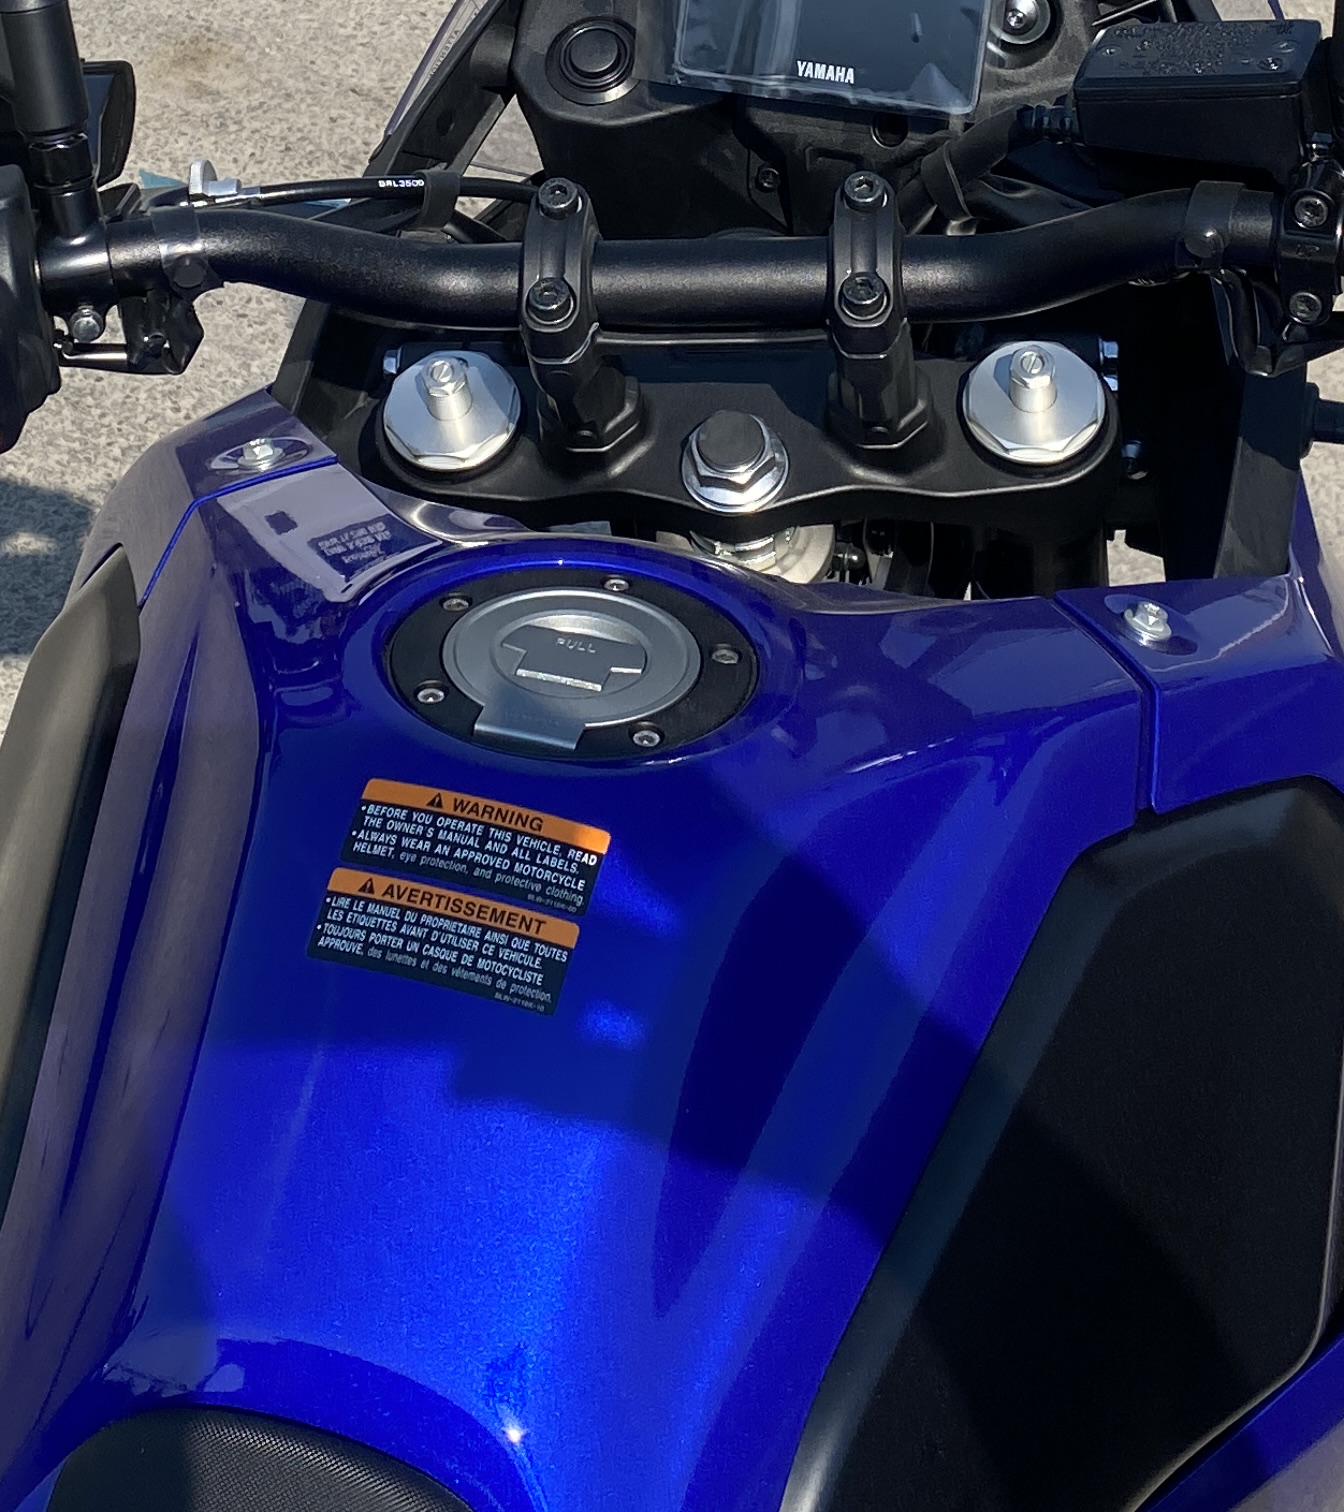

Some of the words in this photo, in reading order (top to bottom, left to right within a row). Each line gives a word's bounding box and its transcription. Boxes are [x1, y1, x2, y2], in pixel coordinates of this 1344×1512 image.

[796, 60, 855, 85] YAMAHA
[557, 637, 596, 654] PULL
[363, 815, 383, 828] THE
[386, 820, 435, 838] OWNER'S
[437, 830, 480, 848] MANUAL
[484, 840, 508, 855] AND
[511, 847, 531, 861] ALL
[366, 804, 408, 820] BEFORE
[412, 811, 434, 825] YOU
[436, 816, 485, 836] OPERATE
[489, 828, 512, 842] THIS
[567, 849, 597, 866] READ
[453, 797, 544, 832] WARNING
[352, 841, 395, 859] HELMET,
[399, 852, 417, 863] eye
[419, 855, 469, 875] protection,
[473, 867, 492, 879] and
[494, 872, 542, 893] protective
[357, 829, 397, 845] ALWAYS
[400, 836, 432, 852] WEAR
[434, 844, 451, 856] AN
[453, 848, 510, 870] APPROVED
[513, 862, 586, 891] MOTORCYCLE
[326, 908, 344, 922] LES
[346, 911, 398, 932] ETIQUETTES
[399, 923, 429, 939] AVANT
[430, 930, 480, 952] D'UTILISER
[481, 943, 496, 956] CE
[331, 896, 351, 909] LIRE
[352, 899, 366, 912] LE
[366, 902, 401, 920] MANUEL
[404, 910, 418, 923] DU
[420, 914, 482, 939] PROPRIETAIRE
[484, 930, 509, 946] AINSI
[511, 937, 531, 952] QUE
[534, 942, 569, 962] TOUTES
[381, 883, 547, 935] AVERTISSEMENT
[322, 922, 367, 942] TOUJOURS
[368, 932, 404, 949] PORTER
[406, 940, 420, 953] UN
[422, 944, 459, 962] CASQUE
[460, 954, 475, 967] DE
[477, 957, 544, 986] MOTOCYCLISTE
[367, 946, 383, 959] des
[420, 959, 429, 970] et
[432, 960, 448, 974] des
[495, 978, 507, 990] de
